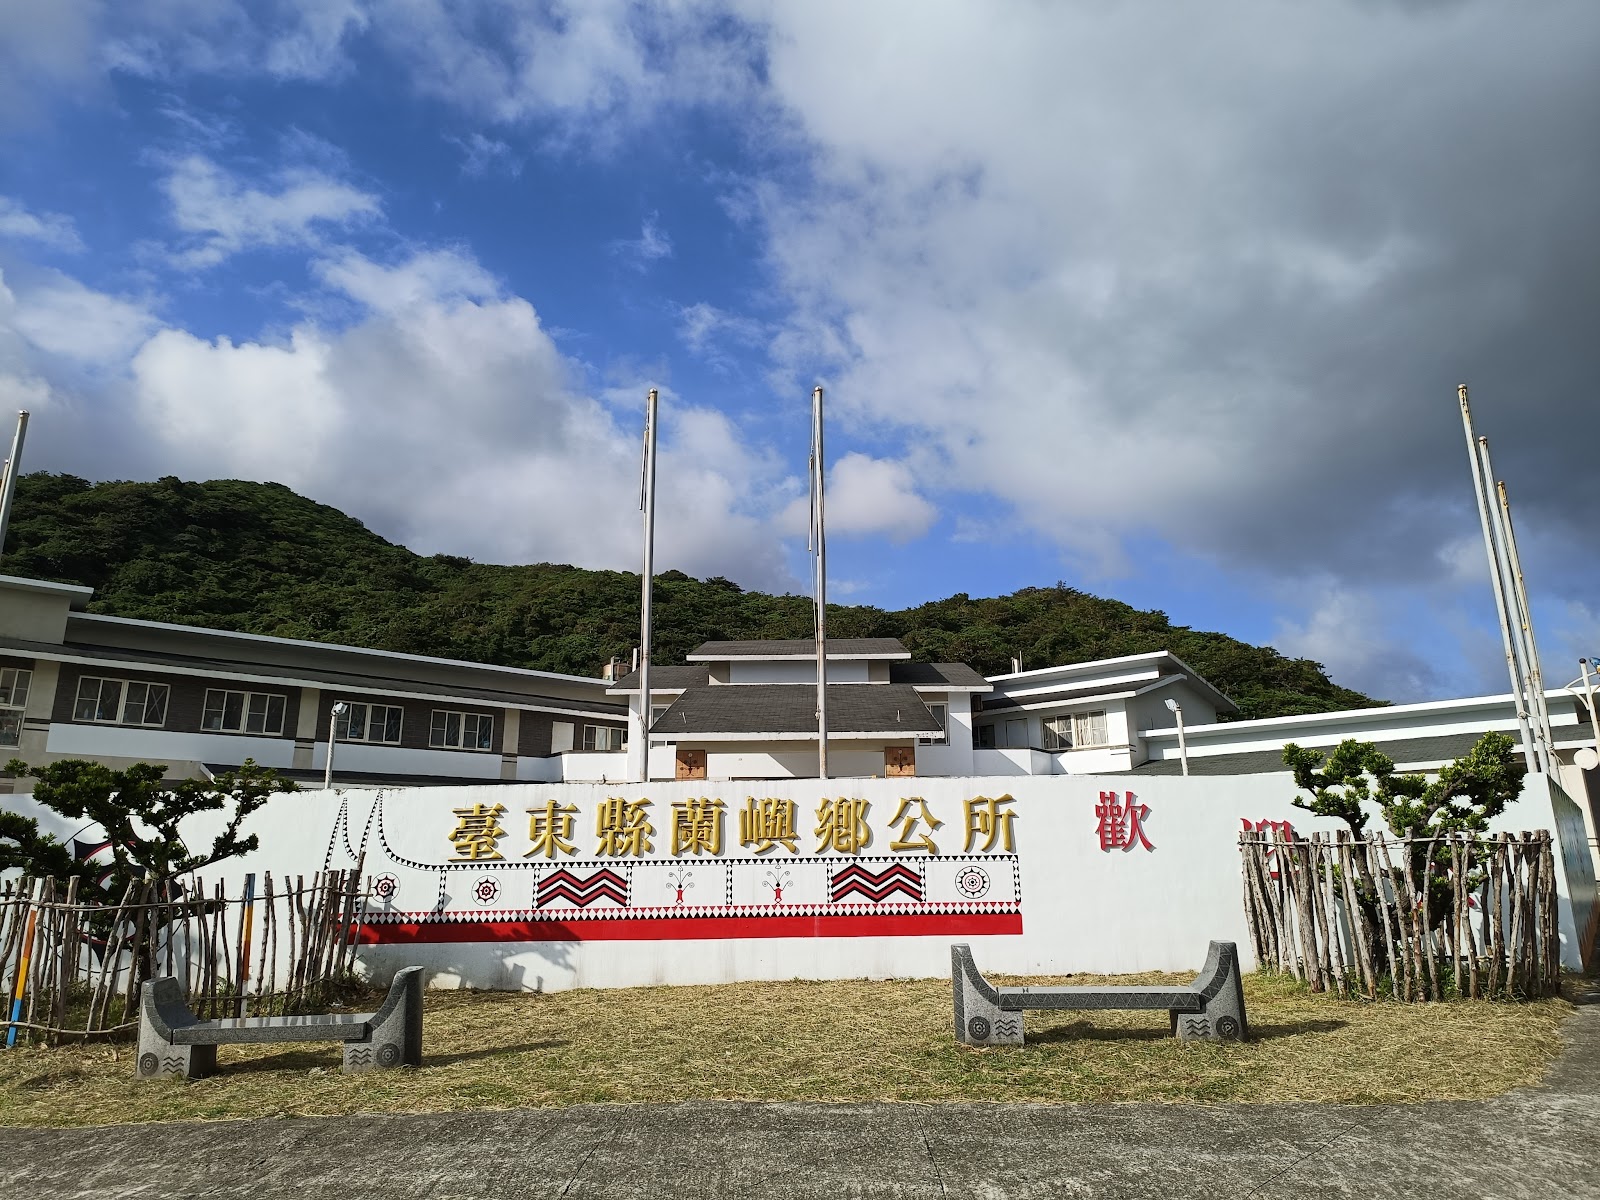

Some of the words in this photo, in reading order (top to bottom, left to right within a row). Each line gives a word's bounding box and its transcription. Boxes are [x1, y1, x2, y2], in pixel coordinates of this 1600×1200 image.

[448, 794, 1017, 861] 臺東縣蘭嶼鄉公所
